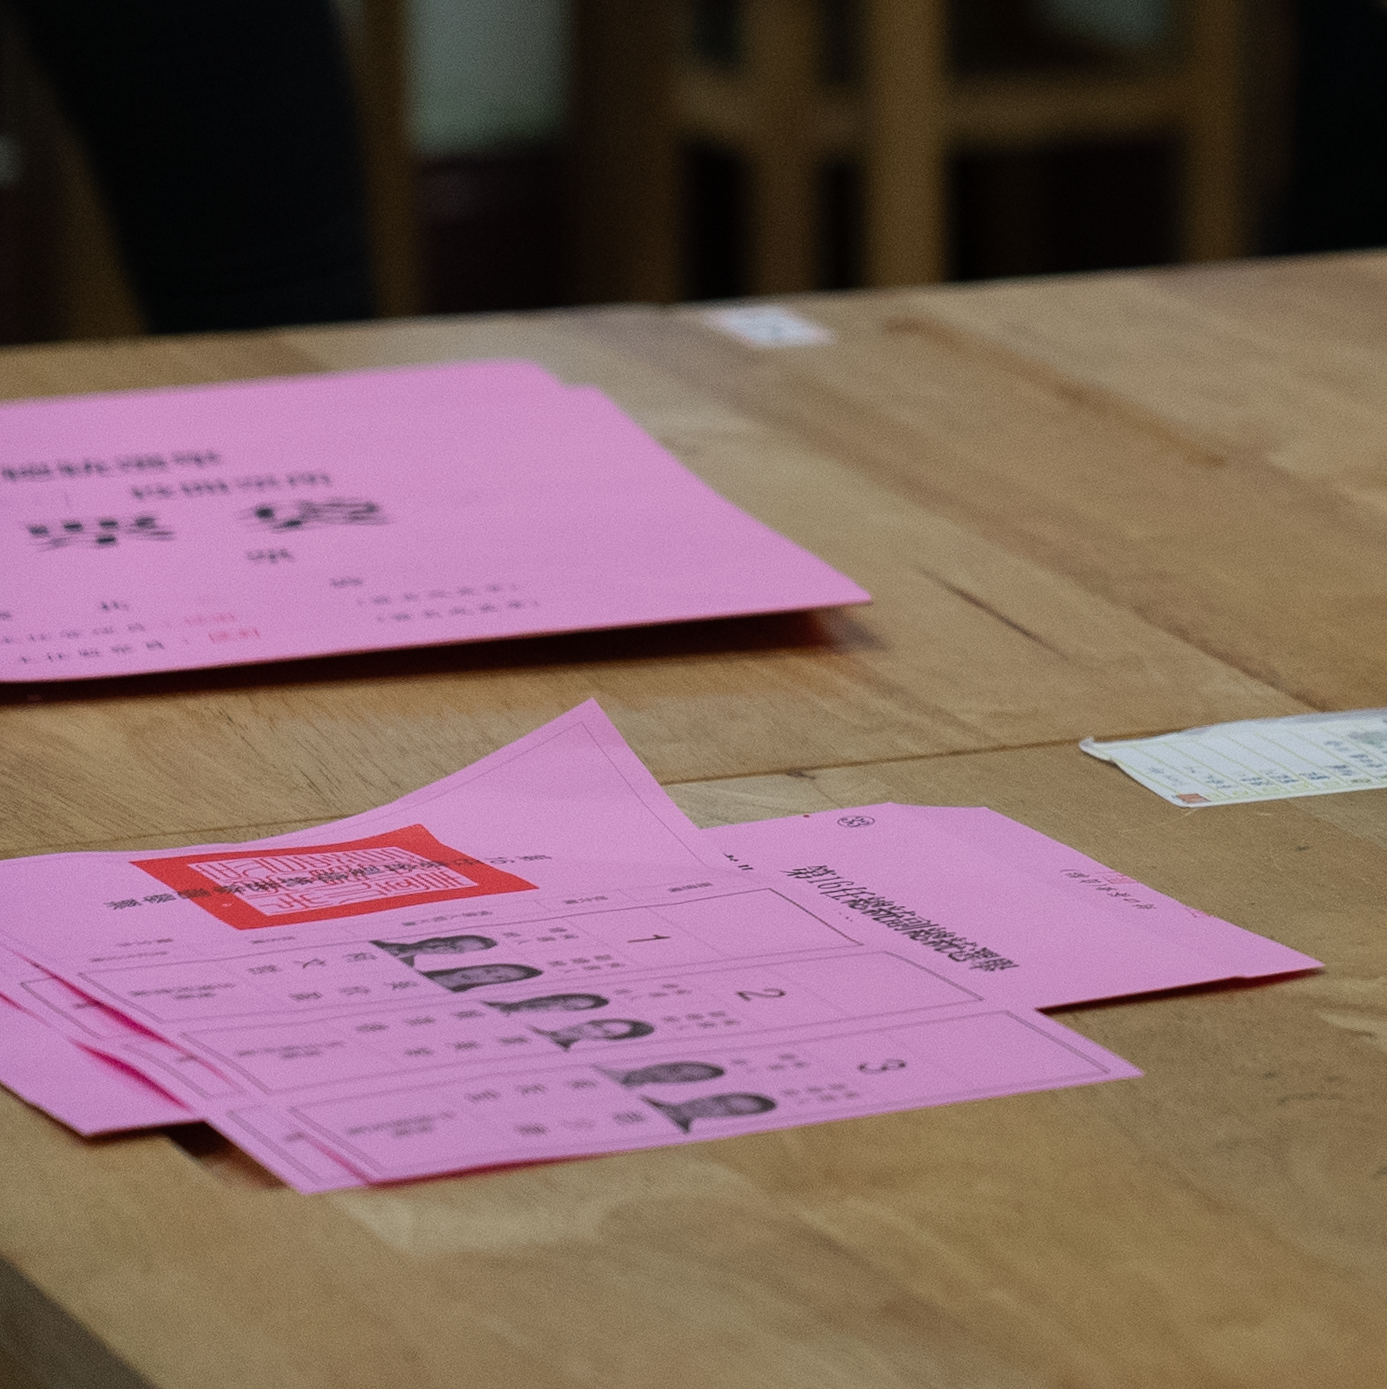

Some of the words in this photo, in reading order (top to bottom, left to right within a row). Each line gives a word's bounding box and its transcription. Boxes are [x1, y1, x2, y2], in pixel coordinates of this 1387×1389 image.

[779, 865, 1020, 971] 第16任總統副總統選舉
[736, 986, 786, 1001] 2
[858, 1056, 907, 1076] 3
